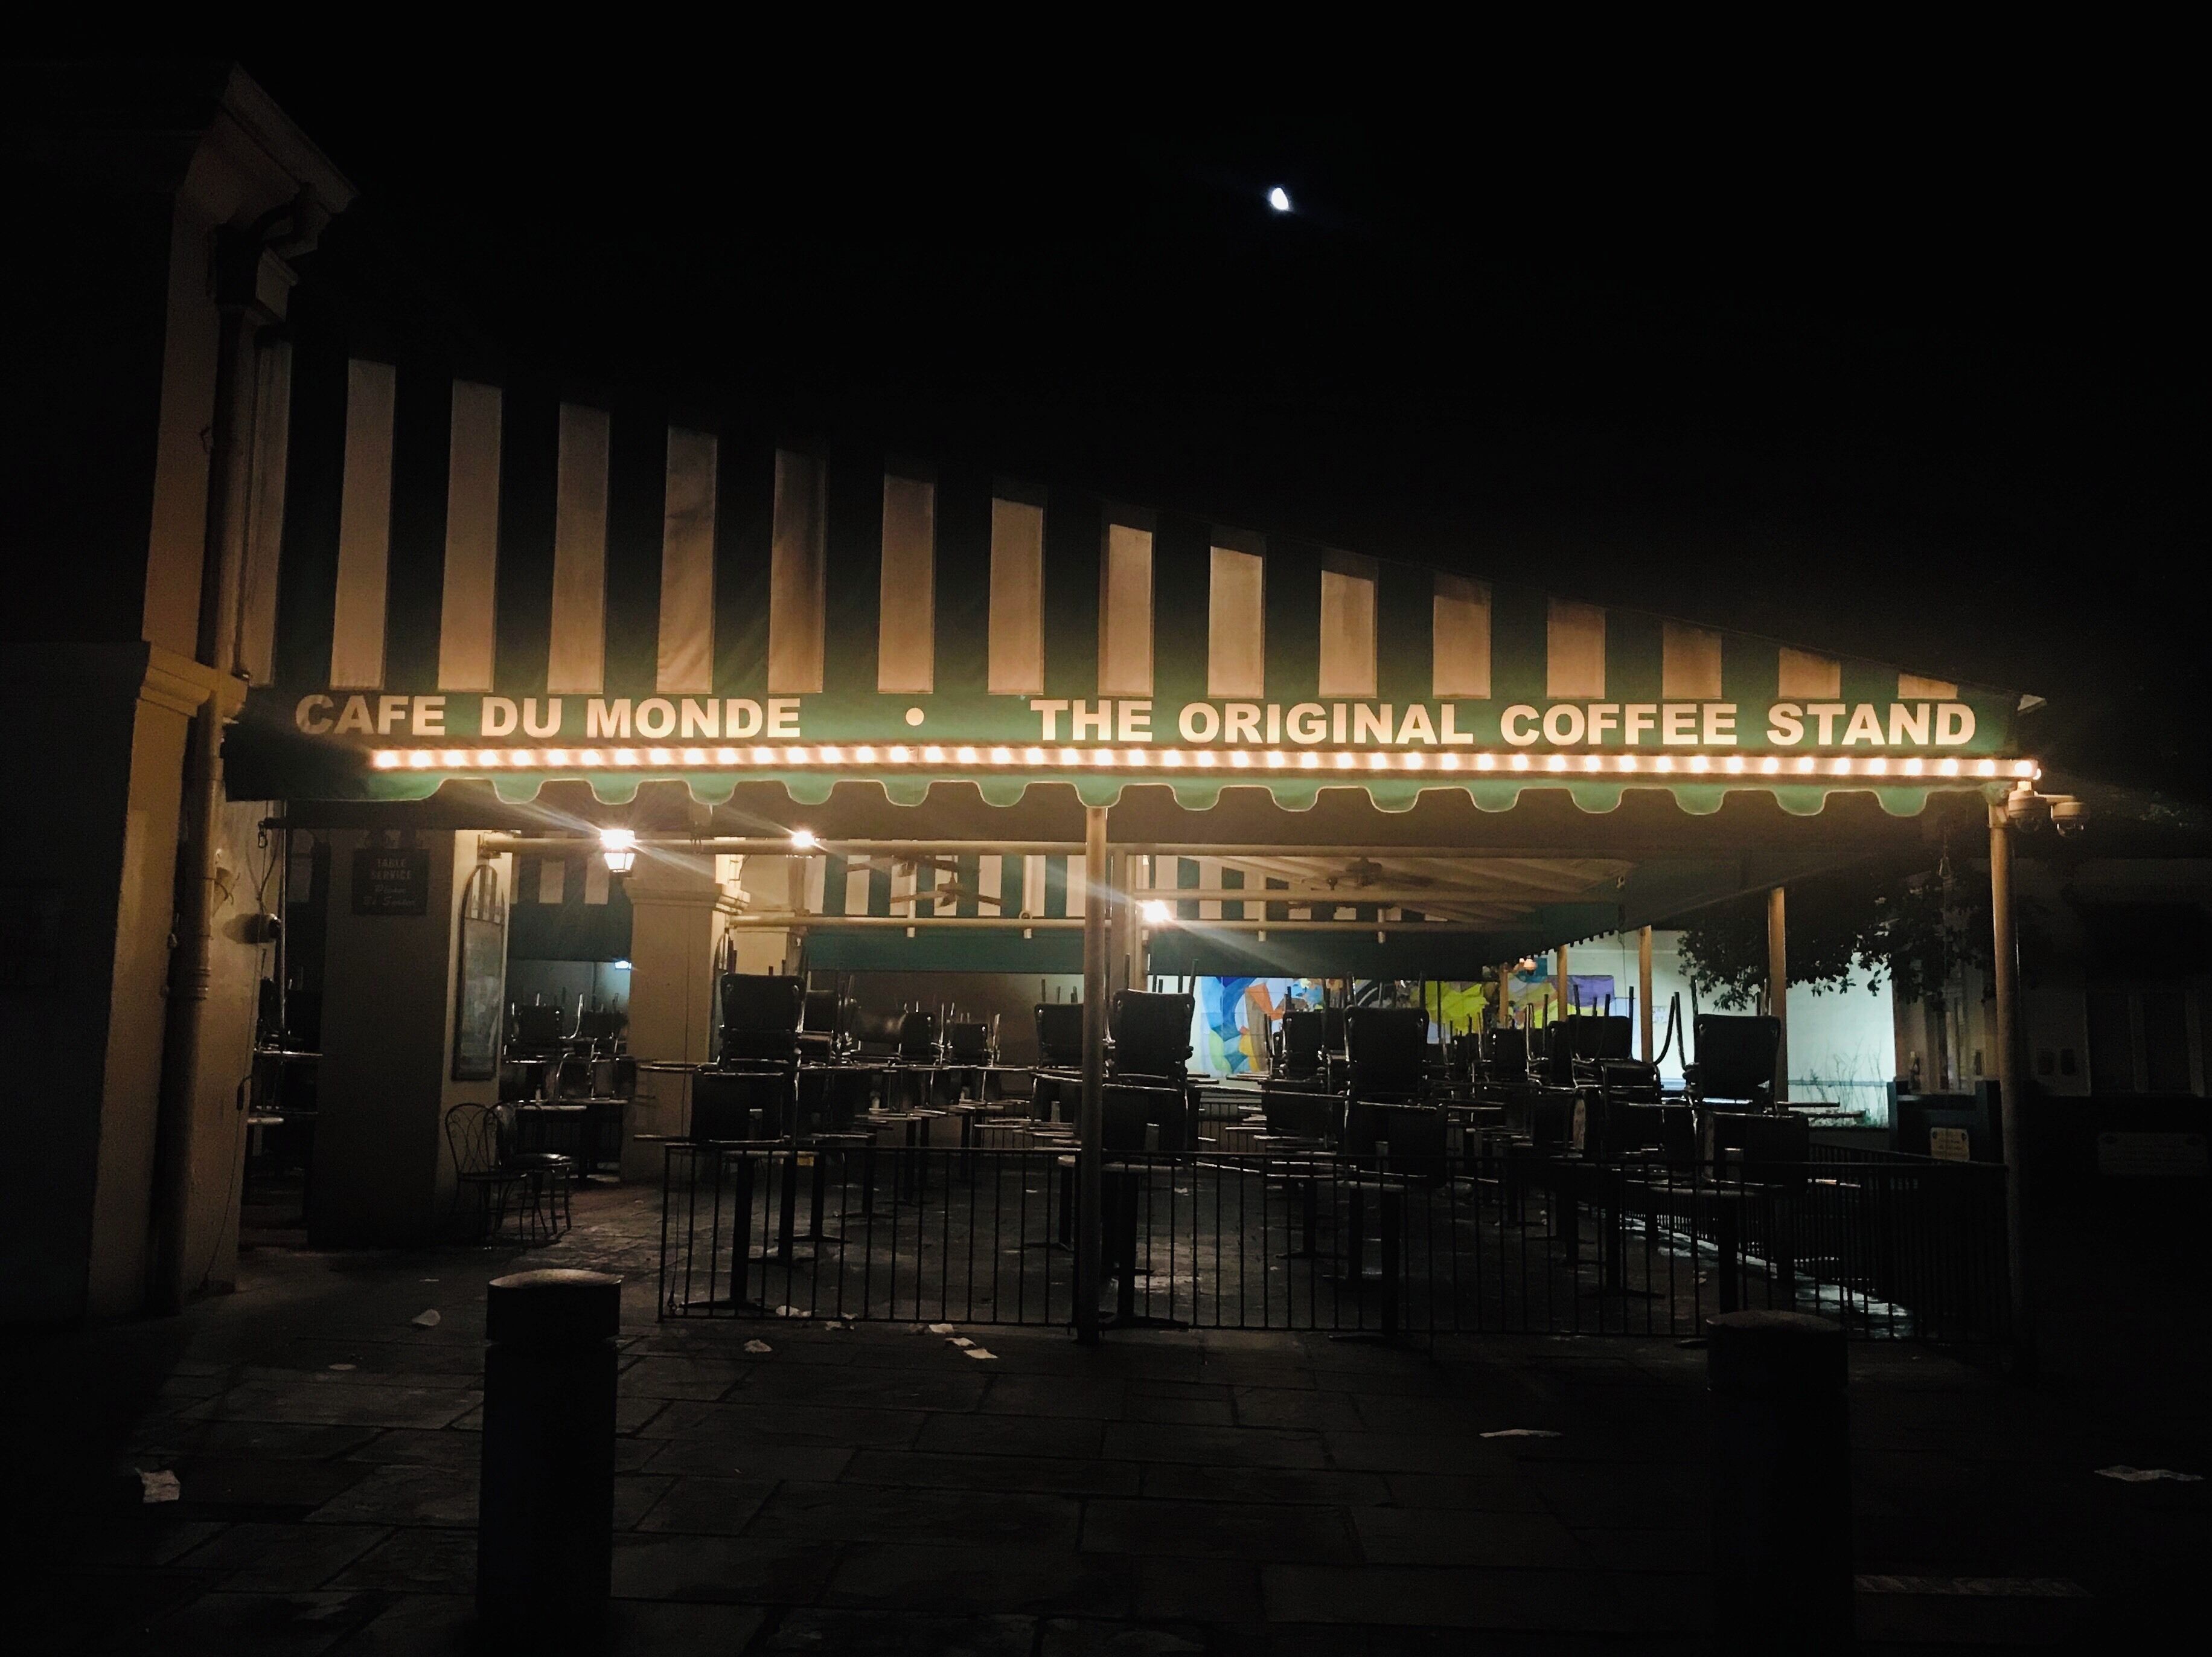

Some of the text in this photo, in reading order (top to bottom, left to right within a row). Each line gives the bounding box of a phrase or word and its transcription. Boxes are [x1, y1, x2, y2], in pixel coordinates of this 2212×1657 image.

[295, 695, 1976, 746] CAFE DU MONDE THE ORIGINAL COFFEE STAND
[376, 857, 407, 868] TABLE
[370, 869, 412, 880] SERVICE
